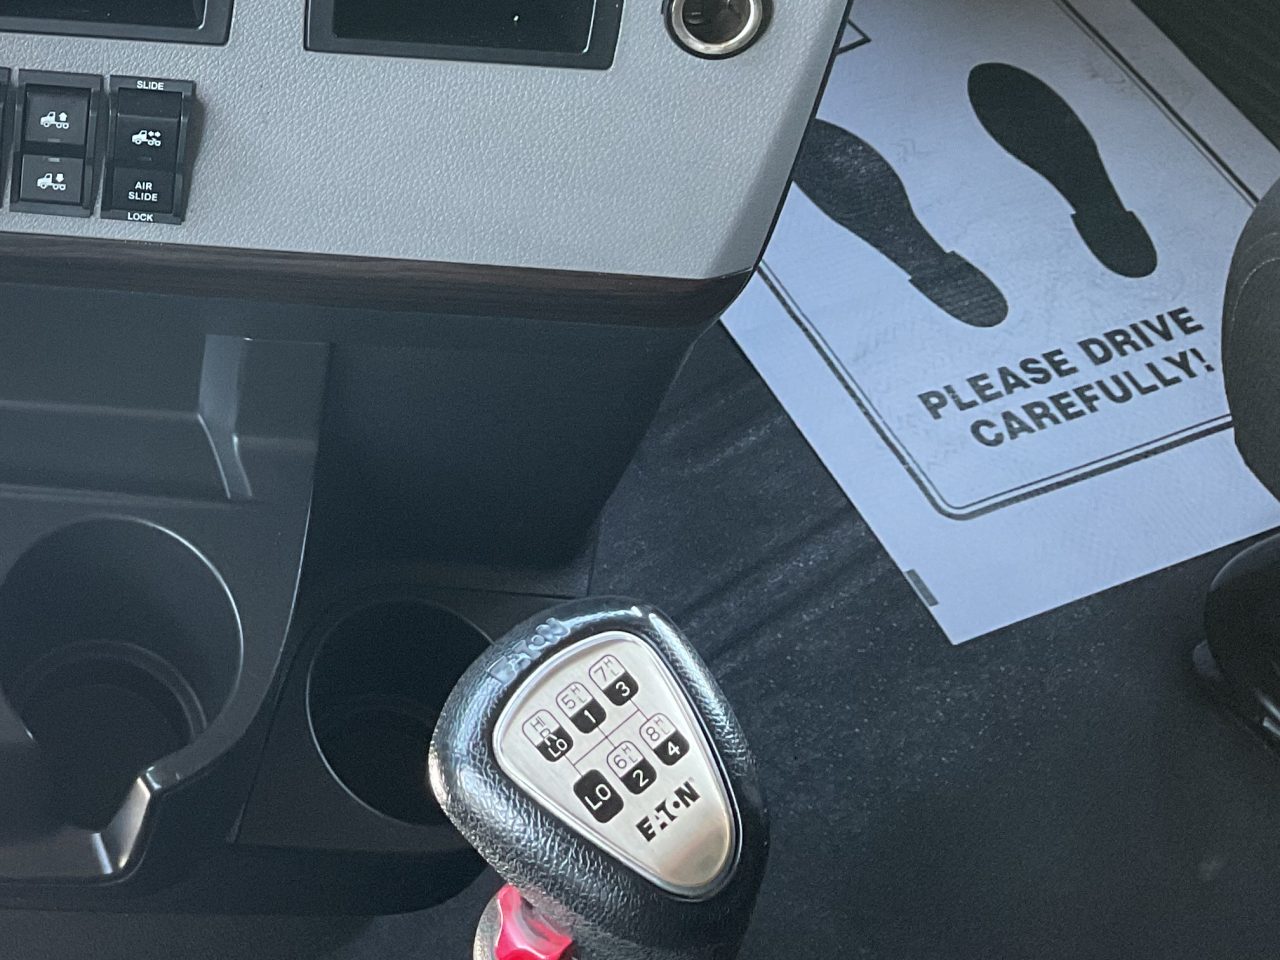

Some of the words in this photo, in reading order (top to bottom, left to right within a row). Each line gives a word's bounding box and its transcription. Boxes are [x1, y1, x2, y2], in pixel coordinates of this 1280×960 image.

[136, 80, 165, 91] SLIDE
[134, 180, 154, 192] AIR
[128, 191, 159, 203] SLIDE
[126, 211, 154, 223] LOCK
[917, 348, 1079, 421] PLEASE
[1077, 305, 1206, 367] DRIVE
[969, 347, 1216, 448] CAREFULLY!
[593, 665, 612, 682] 7
[615, 680, 631, 697] 3
[560, 695, 577, 710] 5
[582, 710, 597, 724] 1
[644, 725, 661, 742] 8
[547, 738, 569, 759] LO
[666, 741, 682, 757] 4
[612, 755, 629, 772] 6
[632, 769, 650, 788] 2
[583, 782, 613, 811] LO
